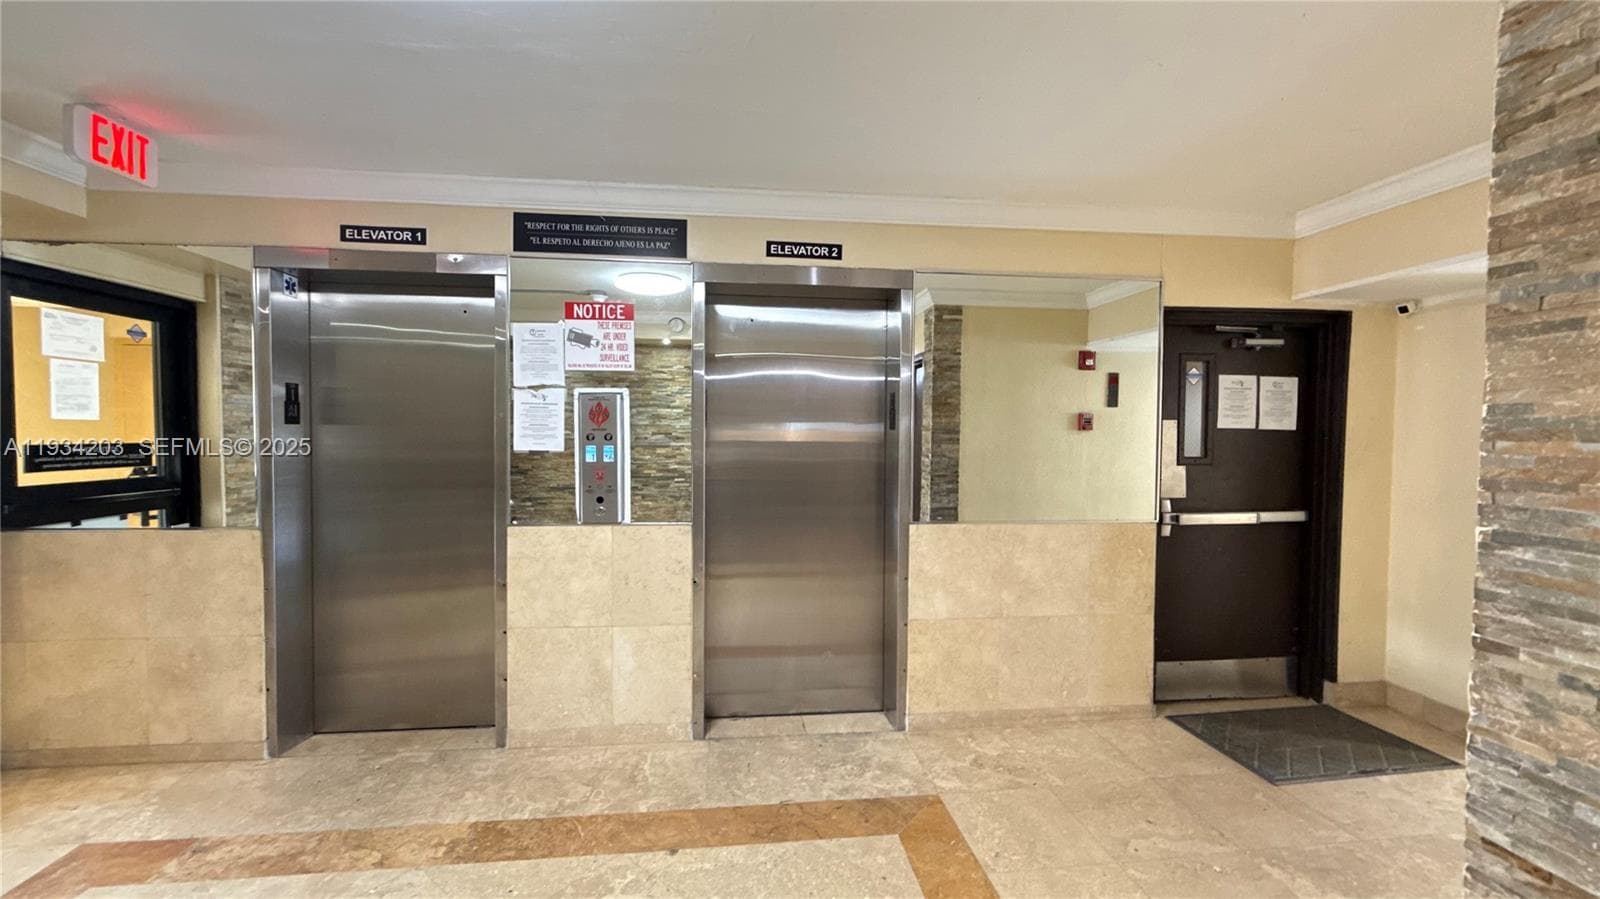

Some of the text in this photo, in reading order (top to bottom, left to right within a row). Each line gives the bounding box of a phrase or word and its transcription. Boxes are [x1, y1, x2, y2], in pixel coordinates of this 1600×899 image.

[90, 111, 150, 181] EXIT
[586, 224, 609, 232] RIGHTS
[620, 226, 646, 234] OTHERS
[345, 229, 422, 241] ELEVATOR 1
[582, 239, 614, 247] DERECHO
[770, 244, 838, 256] ELEVATOR 2
[574, 304, 626, 319] NOTICE
[598, 322, 632, 330] THESE PREMISES
[600, 354, 630, 362] SURVEILLANCE
